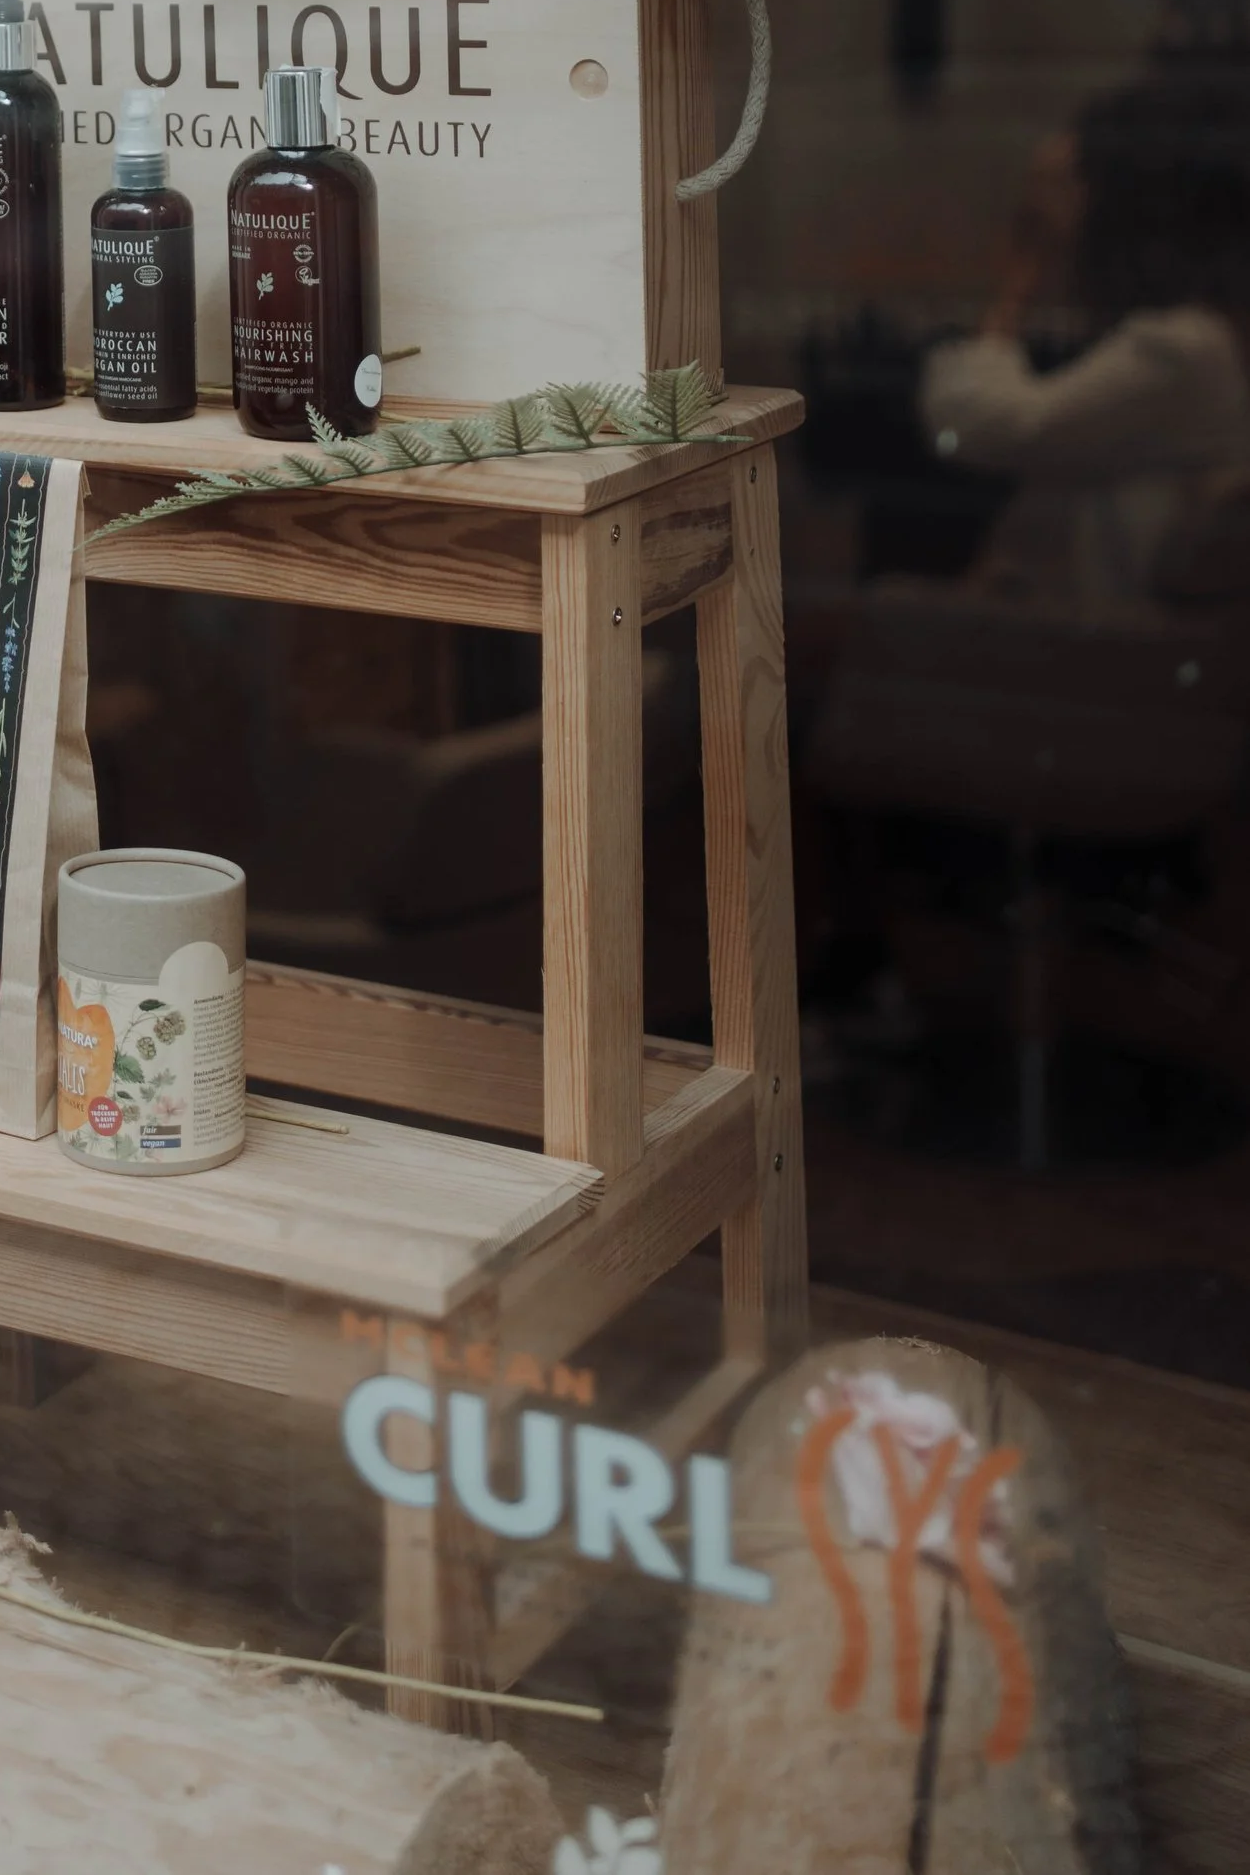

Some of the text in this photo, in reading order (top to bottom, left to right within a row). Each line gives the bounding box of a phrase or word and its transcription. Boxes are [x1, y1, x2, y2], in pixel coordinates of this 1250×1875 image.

[338, 118, 492, 158] BEAUTY
[267, 231, 310, 239] ORGANIC
[271, 321, 312, 329] ORGANIC
[98, 330, 135, 338] EVERYDAY
[234, 325, 312, 342] NOURISHING
[235, 346, 313, 363] HAIRWASH
[131, 362, 156, 373] OIL
[275, 378, 297, 386] mango
[289, 387, 313, 395] protein
[142, 1127, 157, 1135] fair
[143, 1140, 165, 1149] vegan
